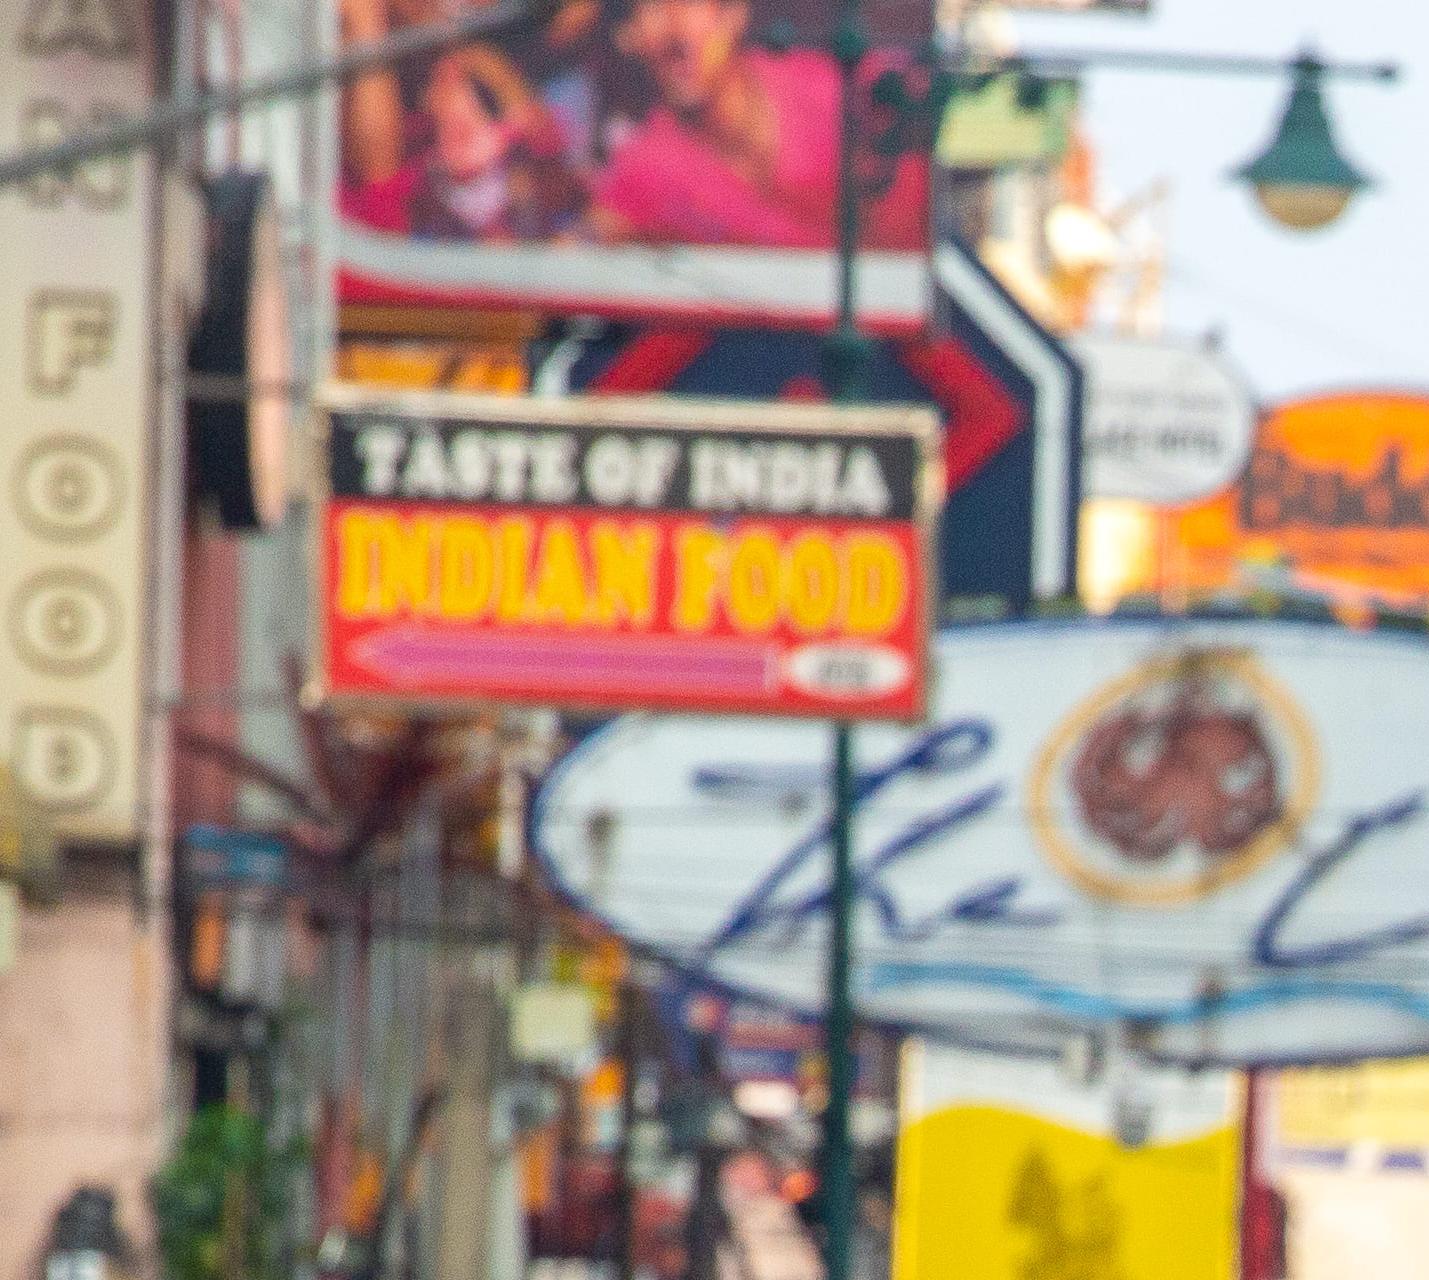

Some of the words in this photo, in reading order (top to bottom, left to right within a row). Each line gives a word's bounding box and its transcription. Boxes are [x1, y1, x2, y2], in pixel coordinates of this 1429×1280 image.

[356, 424, 580, 500] TASTE
[584, 433, 680, 507] OF
[688, 437, 892, 515] INDIA
[10, 287, 124, 816] FOOD
[339, 511, 660, 630] INDIAN
[673, 524, 906, 637] FOOD
